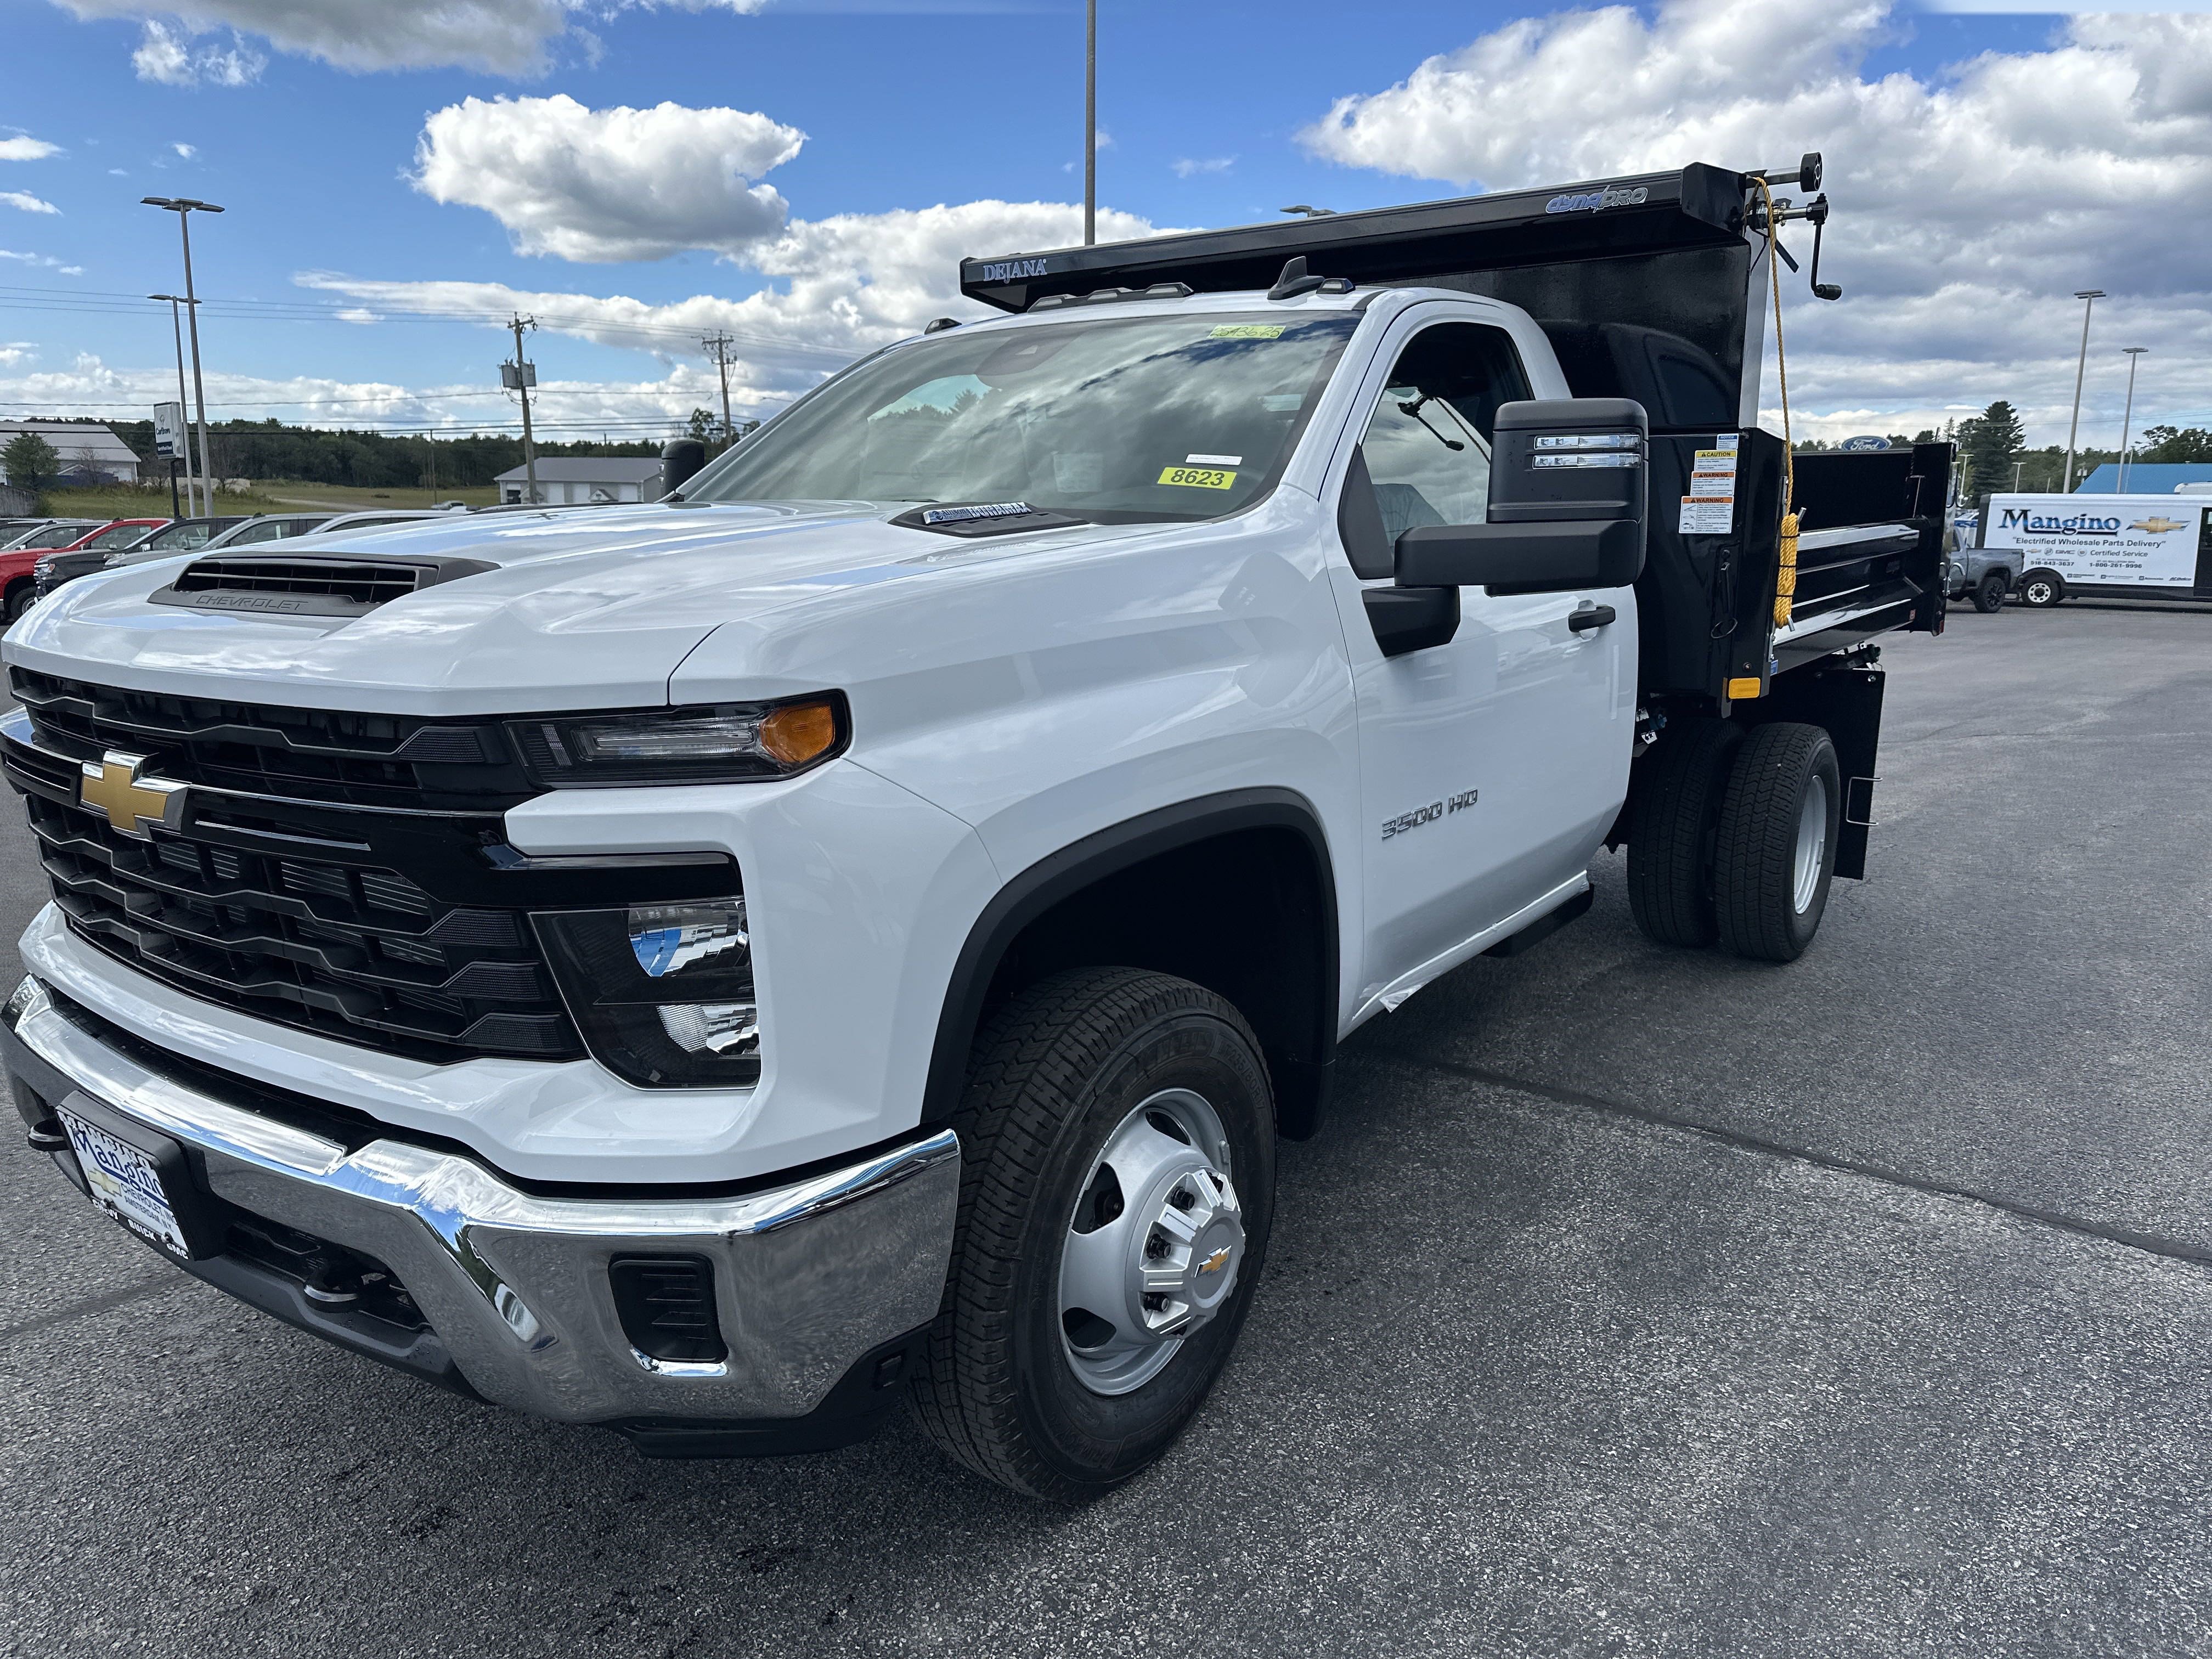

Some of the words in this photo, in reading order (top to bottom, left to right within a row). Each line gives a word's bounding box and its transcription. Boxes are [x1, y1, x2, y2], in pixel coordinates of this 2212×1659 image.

[983, 259, 1047, 284] DEJANA
[1850, 438, 1880, 450] Ford
[1171, 470, 1224, 486] 8623
[967, 502, 1032, 518] DURAMAX
[1998, 509, 2121, 536] Mangino
[196, 595, 308, 610] CHEVROLET
[1382, 801, 1443, 841] 3500
[1448, 789, 1478, 815] HD
[127, 1219, 157, 1242] BUICK
[167, 1243, 189, 1260] GMC
